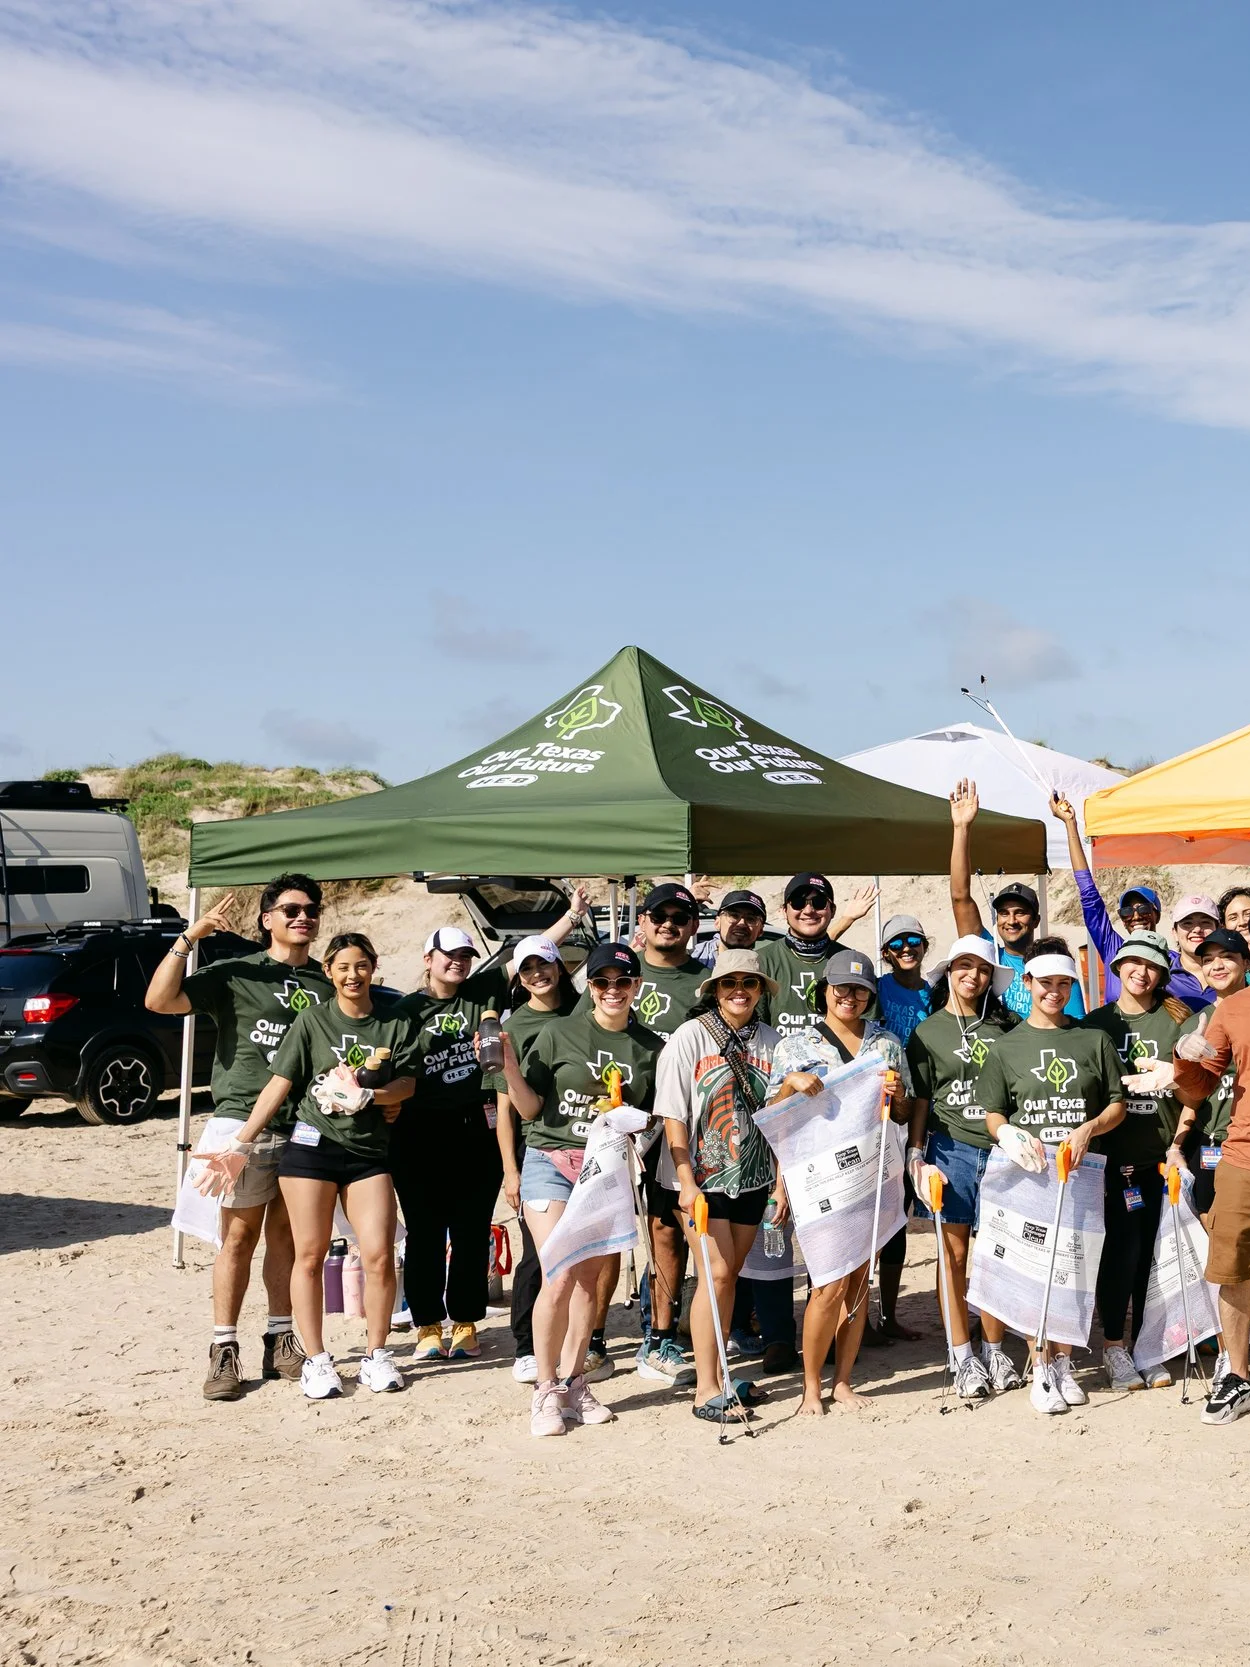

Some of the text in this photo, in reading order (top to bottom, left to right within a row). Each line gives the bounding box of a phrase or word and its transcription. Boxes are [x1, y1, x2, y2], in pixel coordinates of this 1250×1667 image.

[481, 742, 606, 764] Our Texas
[695, 741, 801, 760] Our Texas
[458, 757, 595, 778] Our Future
[709, 755, 825, 773] Our Future
[256, 1018, 287, 1035] Our
[778, 1012, 806, 1025] Our
[249, 1030, 280, 1046] Our
[424, 1049, 449, 1066] Our
[450, 1040, 476, 1055] Tex
[425, 1061, 451, 1075] Our
[951, 1079, 974, 1092] Our
[563, 1088, 594, 1104] Our
[946, 1092, 971, 1106] Our
[558, 1101, 586, 1117] Our
[1024, 1096, 1087, 1113] Our Texa
[1019, 1110, 1087, 1125] Our Futur
[837, 1154, 861, 1169] Clean
[1021, 1230, 1045, 1245] Clean
